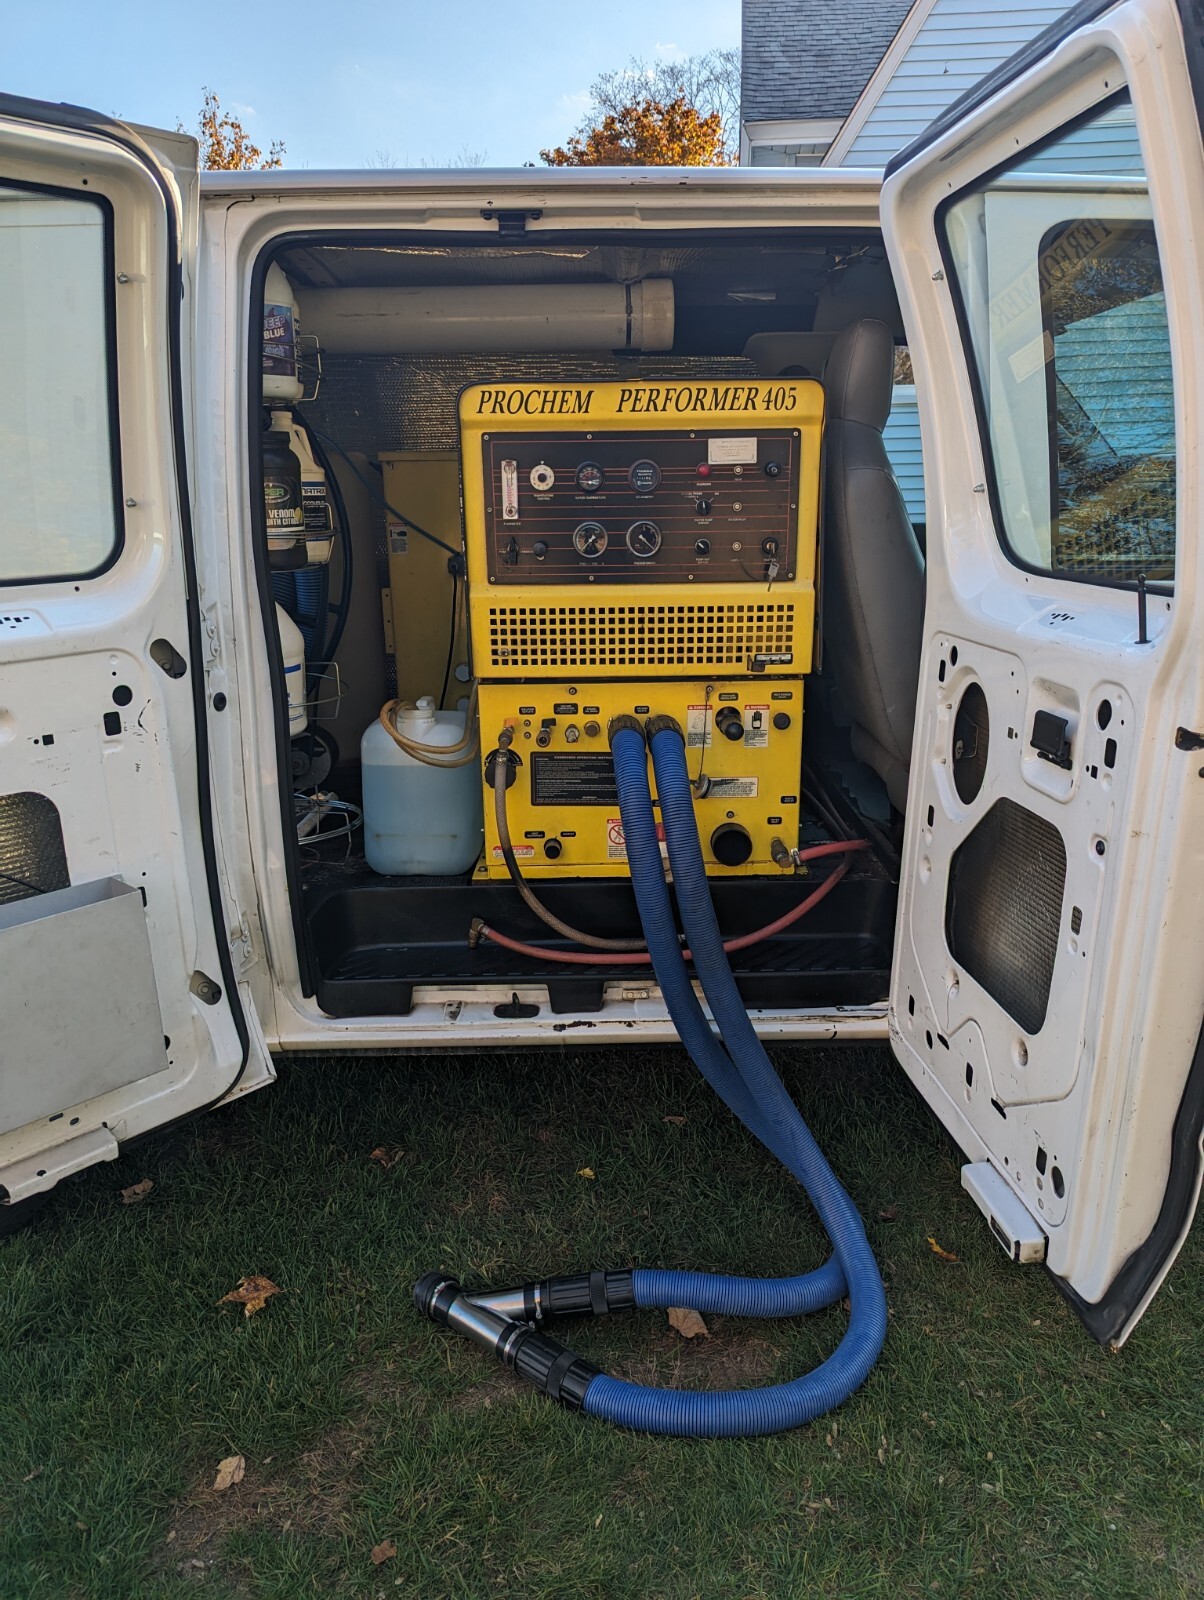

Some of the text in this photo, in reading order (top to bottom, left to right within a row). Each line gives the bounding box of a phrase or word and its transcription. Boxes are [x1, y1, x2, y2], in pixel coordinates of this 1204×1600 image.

[264, 315, 286, 330] EEP
[263, 327, 285, 340] BLUE
[476, 386, 798, 414] PROCHEM PERFORMER 405
[268, 508, 295, 518] VENOM
